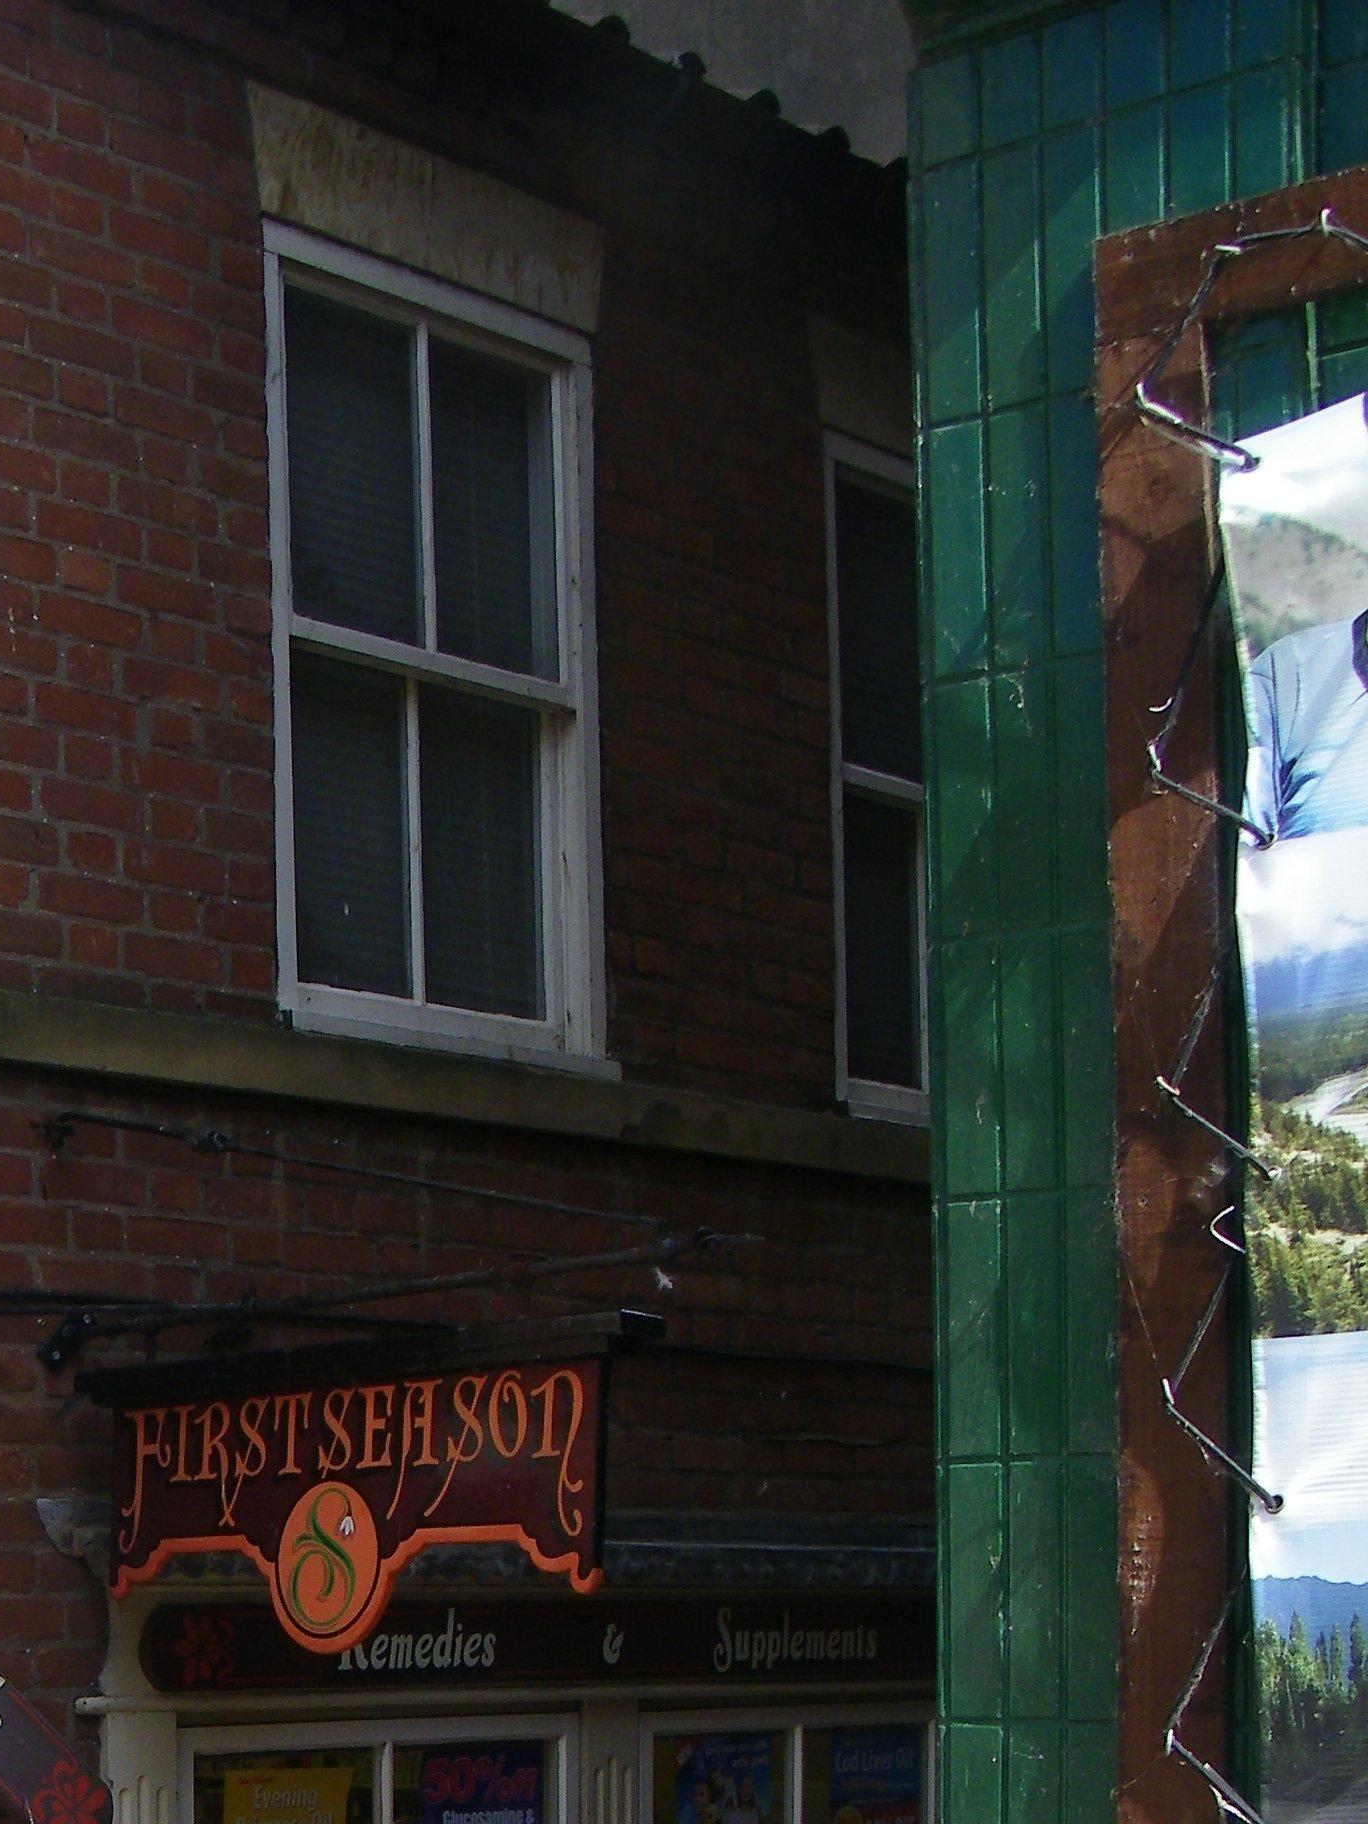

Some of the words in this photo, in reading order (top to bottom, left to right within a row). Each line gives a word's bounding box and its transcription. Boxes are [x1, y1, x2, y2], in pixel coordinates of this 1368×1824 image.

[602, 1623, 626, 1666] &
[713, 1606, 878, 1673] Supplements
[253, 1785, 320, 1812] Evening
[526, 1809, 535, 1824] &
